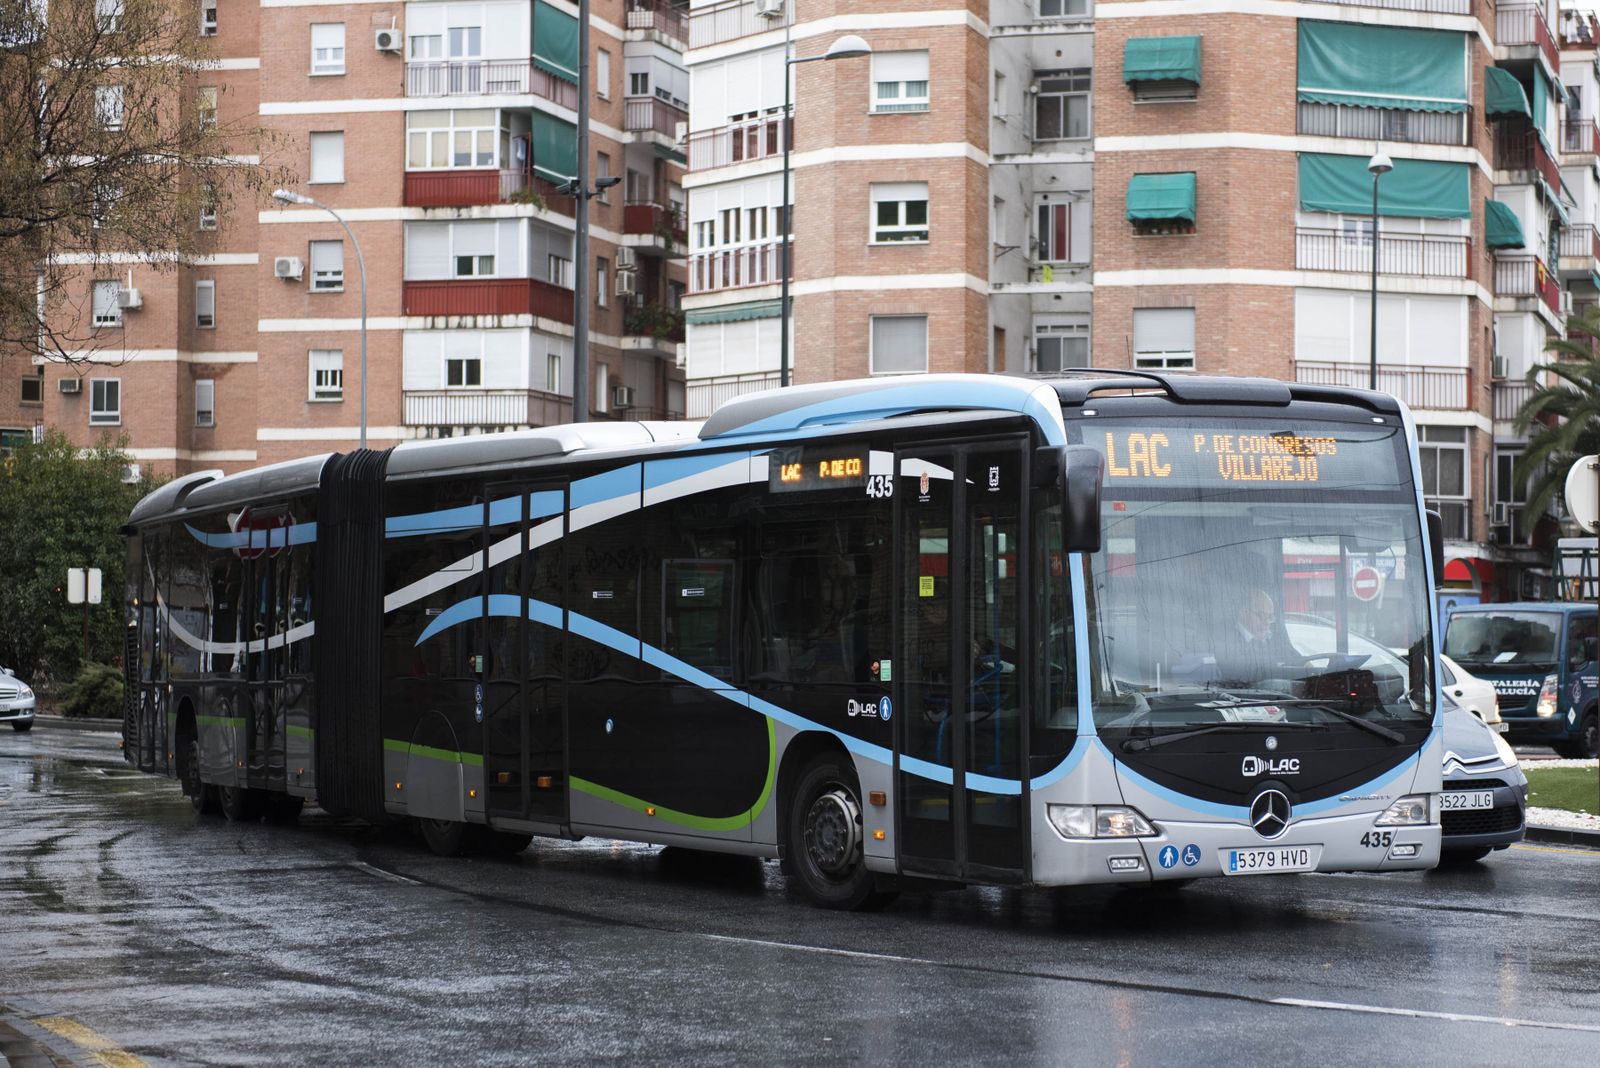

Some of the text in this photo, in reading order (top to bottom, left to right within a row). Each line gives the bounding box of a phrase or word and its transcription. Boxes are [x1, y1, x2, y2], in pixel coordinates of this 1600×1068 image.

[1105, 432, 1172, 477] LAC
[1194, 434, 1337, 456] P. DE CONGRESOS
[780, 458, 861, 482] LAC P. DE CO
[1218, 454, 1319, 481] VILLAREJO
[866, 475, 894, 499] 435
[1489, 679, 1541, 688] TALERÍA
[861, 703, 877, 714] LAC
[1269, 758, 1300, 771] LAC
[1470, 793, 1491, 808] JLG
[1360, 831, 1392, 848] 435
[1238, 849, 1308, 869] 5379 HVD
